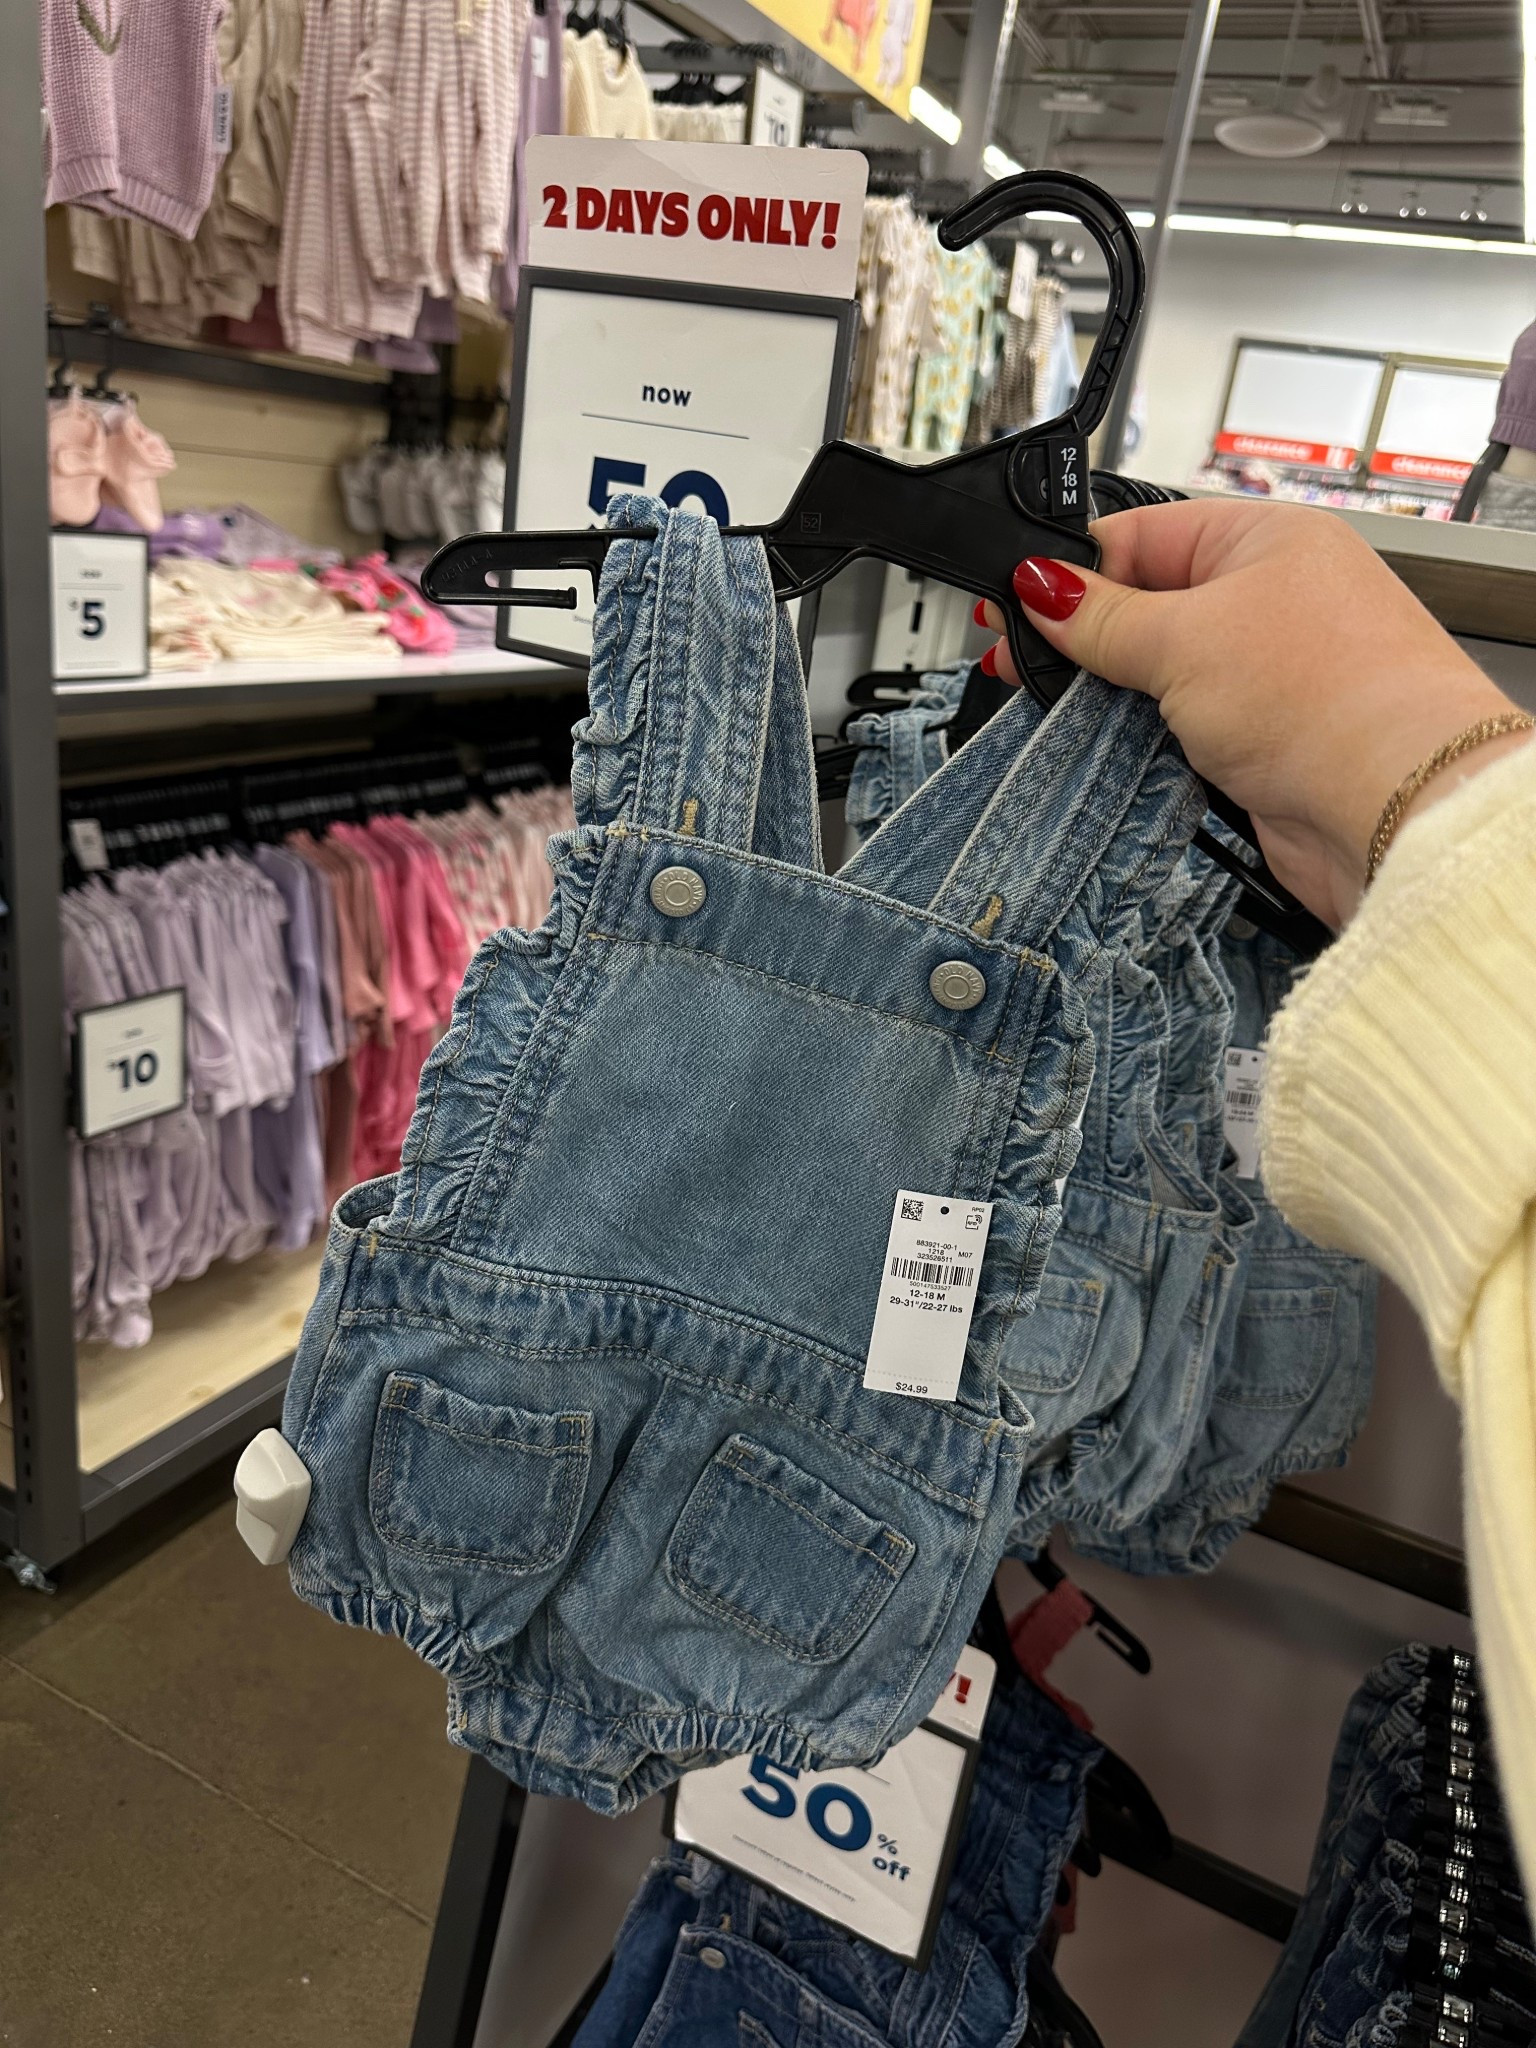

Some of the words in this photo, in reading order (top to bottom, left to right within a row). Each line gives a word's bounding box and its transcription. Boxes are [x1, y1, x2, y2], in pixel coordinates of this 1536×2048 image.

[542, 184, 568, 229] 2
[576, 186, 689, 237] DAYS
[697, 194, 841, 250] ONLY!
[642, 385, 692, 407] now
[1061, 447, 1077, 462] 12
[1061, 473, 1078, 487] 18
[1062, 490, 1077, 505] M
[928, 1248, 945, 1256] 1218
[910, 1289, 935, 1299] 12-18
[936, 1293, 946, 1301] M
[949, 1305, 963, 1313] lbs
[895, 1381, 928, 1394] $24.99
[740, 1753, 873, 1851] 50
[872, 1855, 911, 1882] off
